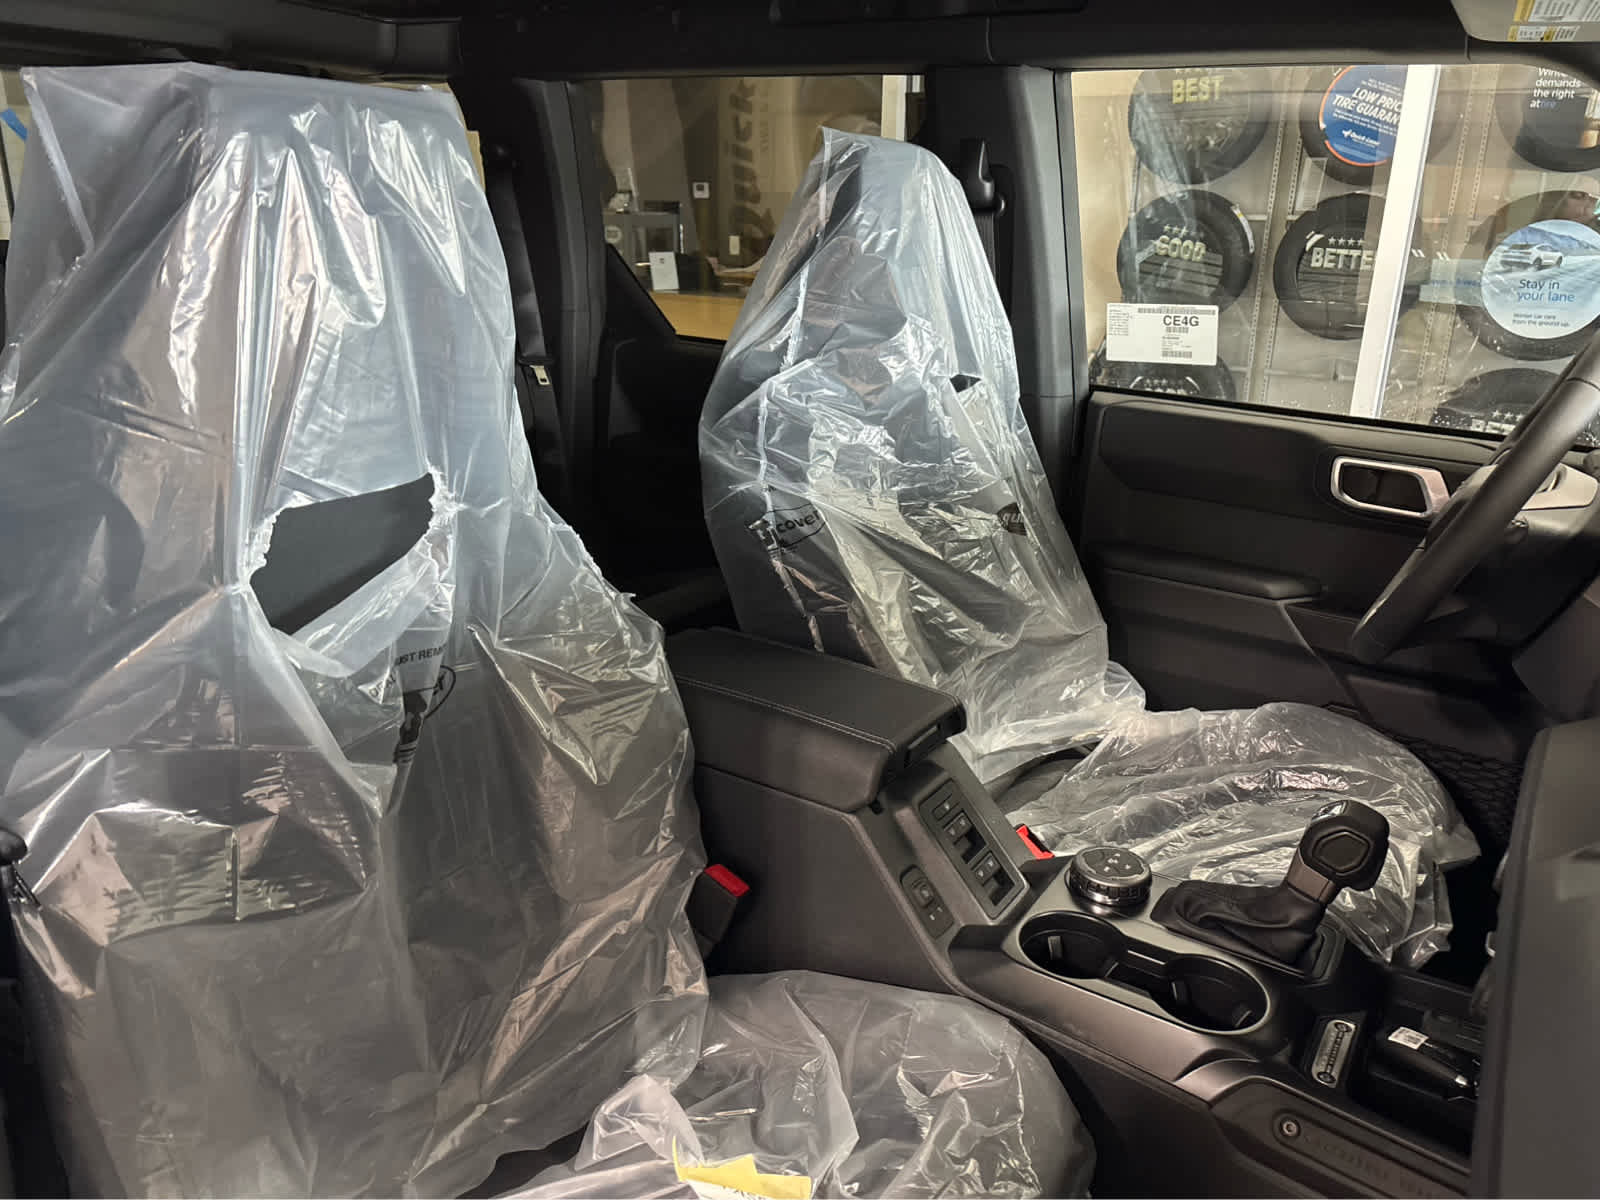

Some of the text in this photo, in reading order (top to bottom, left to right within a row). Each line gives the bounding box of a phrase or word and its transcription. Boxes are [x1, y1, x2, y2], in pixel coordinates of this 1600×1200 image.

[1172, 75, 1224, 104] BEST
[1535, 78, 1582, 88] demands
[1352, 87, 1403, 113] LOW PRIC
[1533, 88, 1575, 100] the right
[1332, 94, 1358, 110] TIRE
[1356, 102, 1401, 125] GUARAN
[1156, 235, 1206, 262] GOOD
[1311, 247, 1376, 271] BETTE
[1519, 279, 1560, 290] Stay in
[1517, 291, 1575, 302] your lane
[1163, 315, 1200, 327] CE4G
[418, 646, 442, 661] REM
